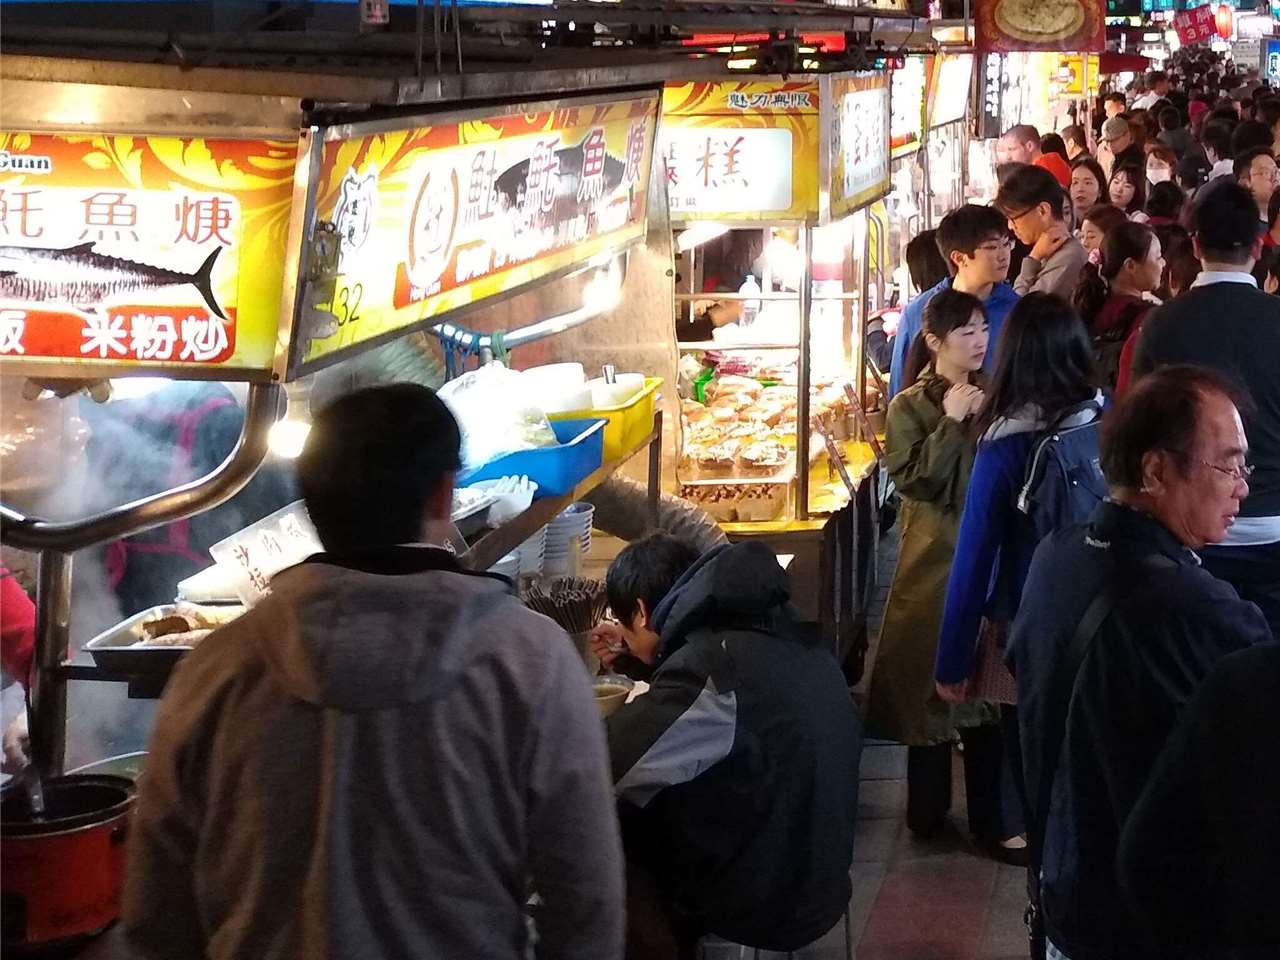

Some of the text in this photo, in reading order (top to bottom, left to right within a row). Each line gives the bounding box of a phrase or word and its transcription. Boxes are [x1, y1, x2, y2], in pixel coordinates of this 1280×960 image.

[729, 92, 811, 109] 魅力無限
[79, 313, 229, 361] 米粉炒
